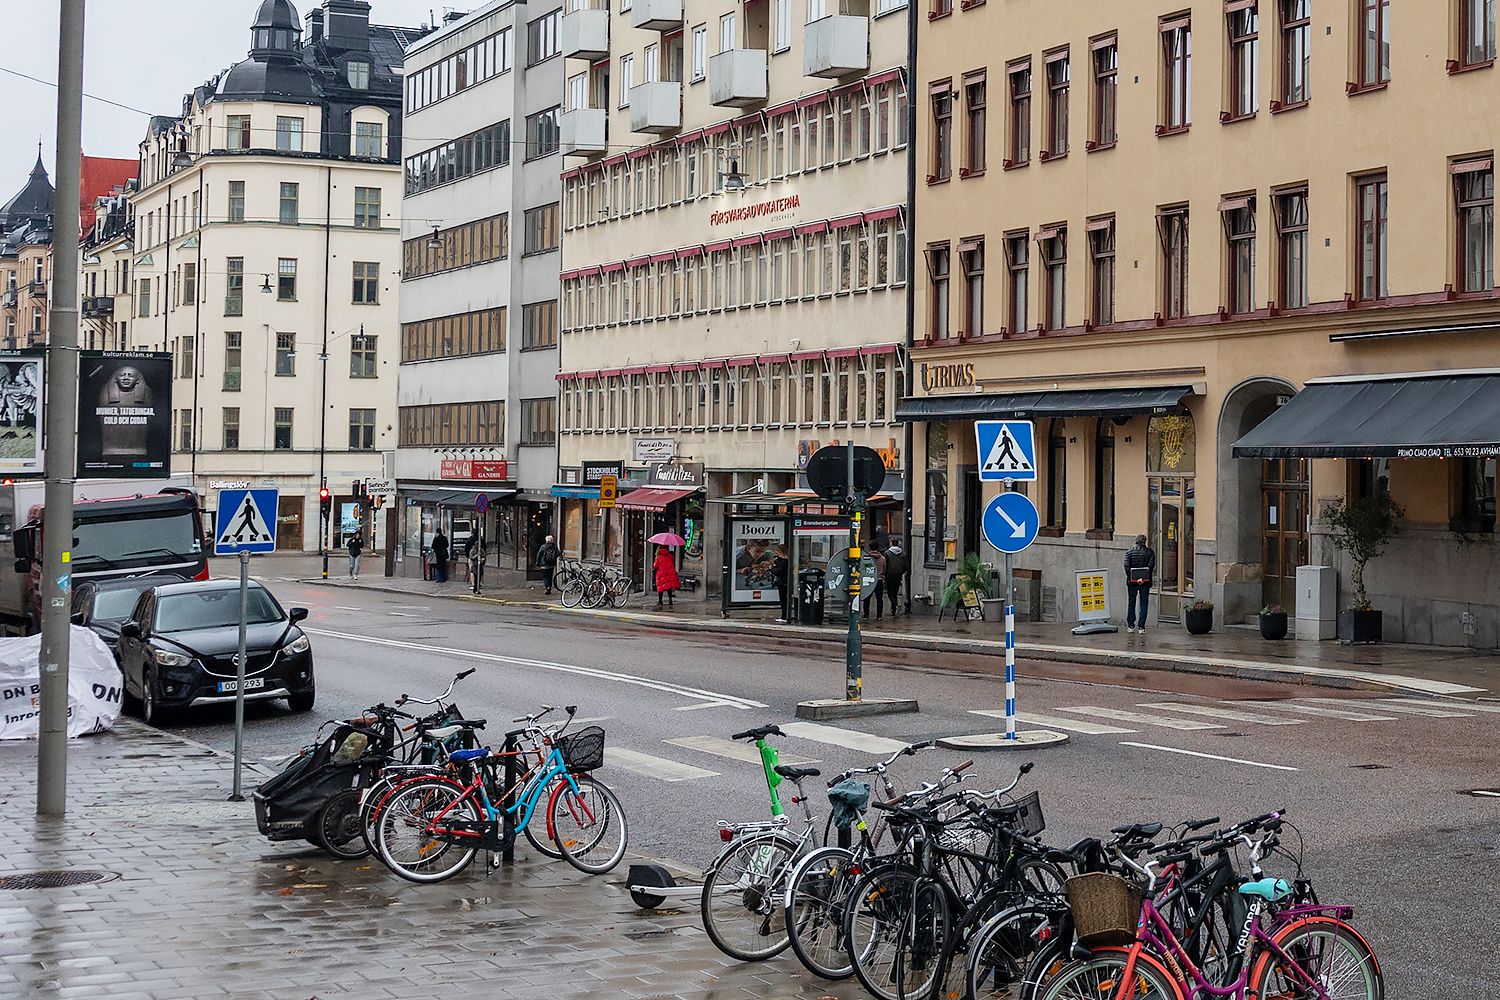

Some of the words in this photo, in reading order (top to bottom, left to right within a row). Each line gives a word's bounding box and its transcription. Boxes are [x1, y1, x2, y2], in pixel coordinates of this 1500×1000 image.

[711, 195, 800, 226] FÖRSVARSADVOKATERNA
[1397, 448, 1414, 457] PRIMO
[1414, 448, 1428, 457] CIAO
[1427, 448, 1441, 457] CIAO
[1453, 447, 1464, 456] 653
[1472, 447, 1480, 456] 23
[741, 524, 776, 535] Boozt
[3, 686, 26, 700] DN
[92, 683, 121, 703] DN
